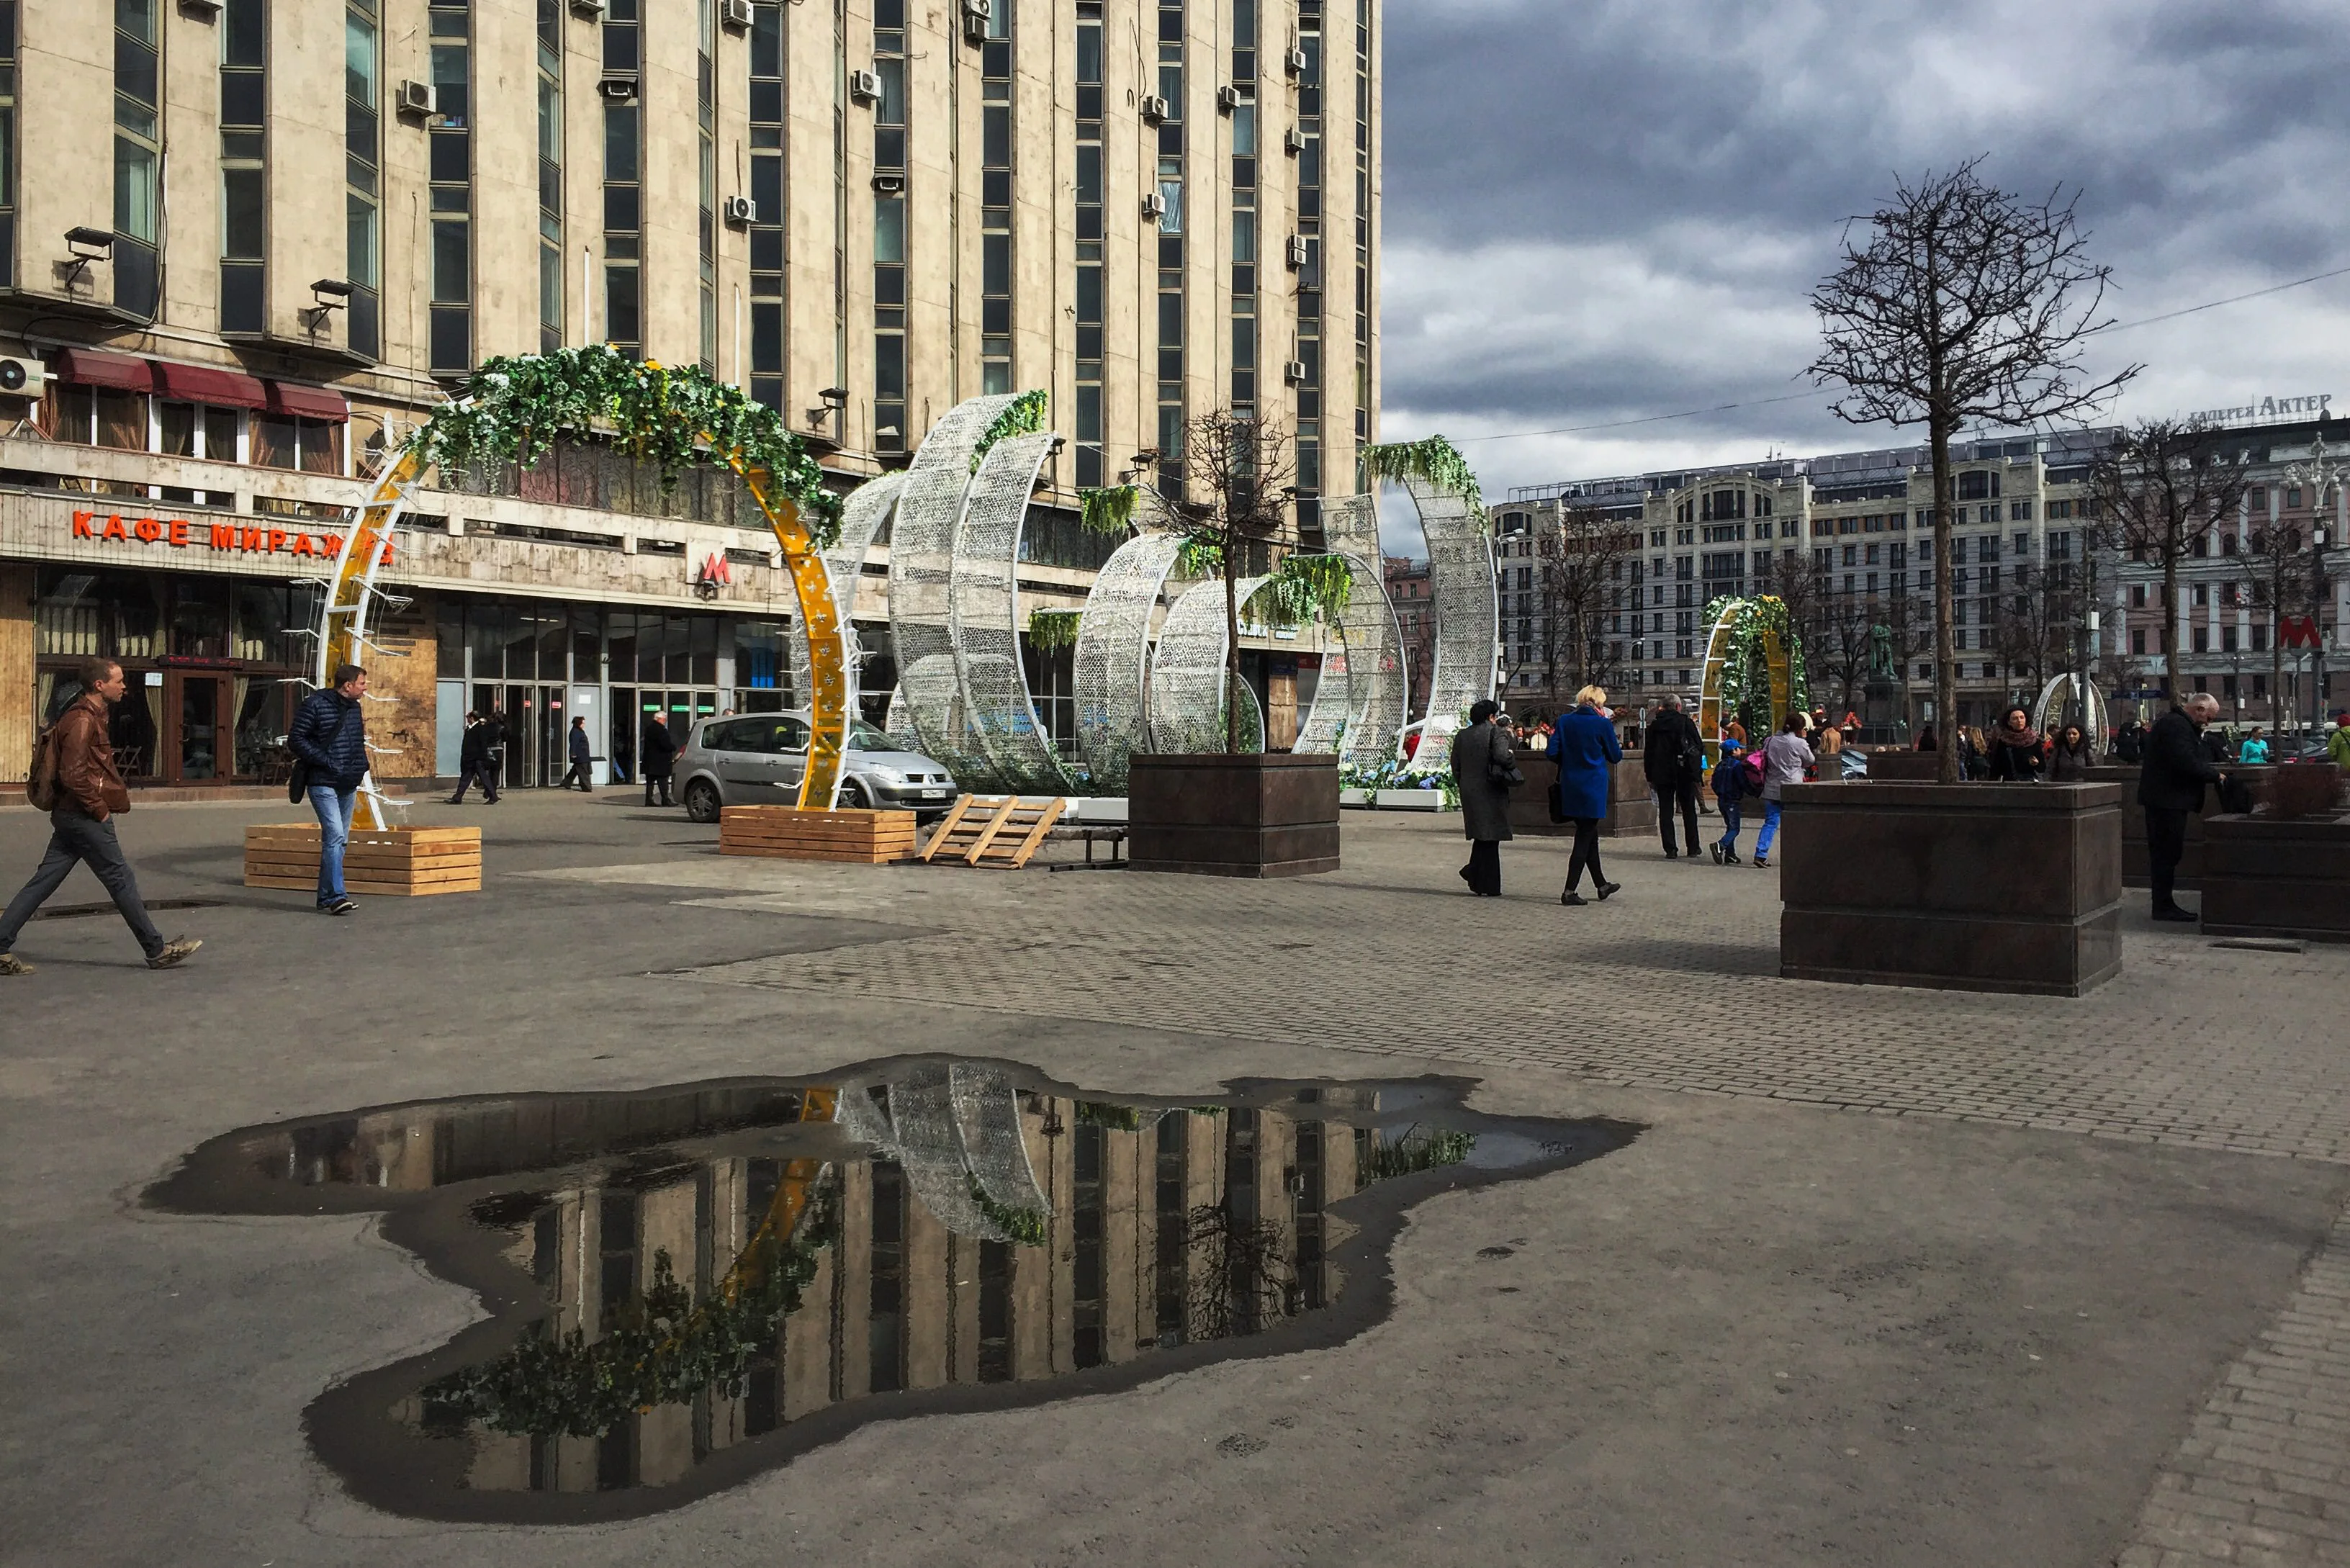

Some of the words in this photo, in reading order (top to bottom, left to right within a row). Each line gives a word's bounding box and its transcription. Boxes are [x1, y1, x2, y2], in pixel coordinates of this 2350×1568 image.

[2259, 395, 2332, 416] АКТЕР
[73, 510, 189, 545] КАФЕ
[703, 552, 731, 584] М
[2280, 616, 2323, 648] М
